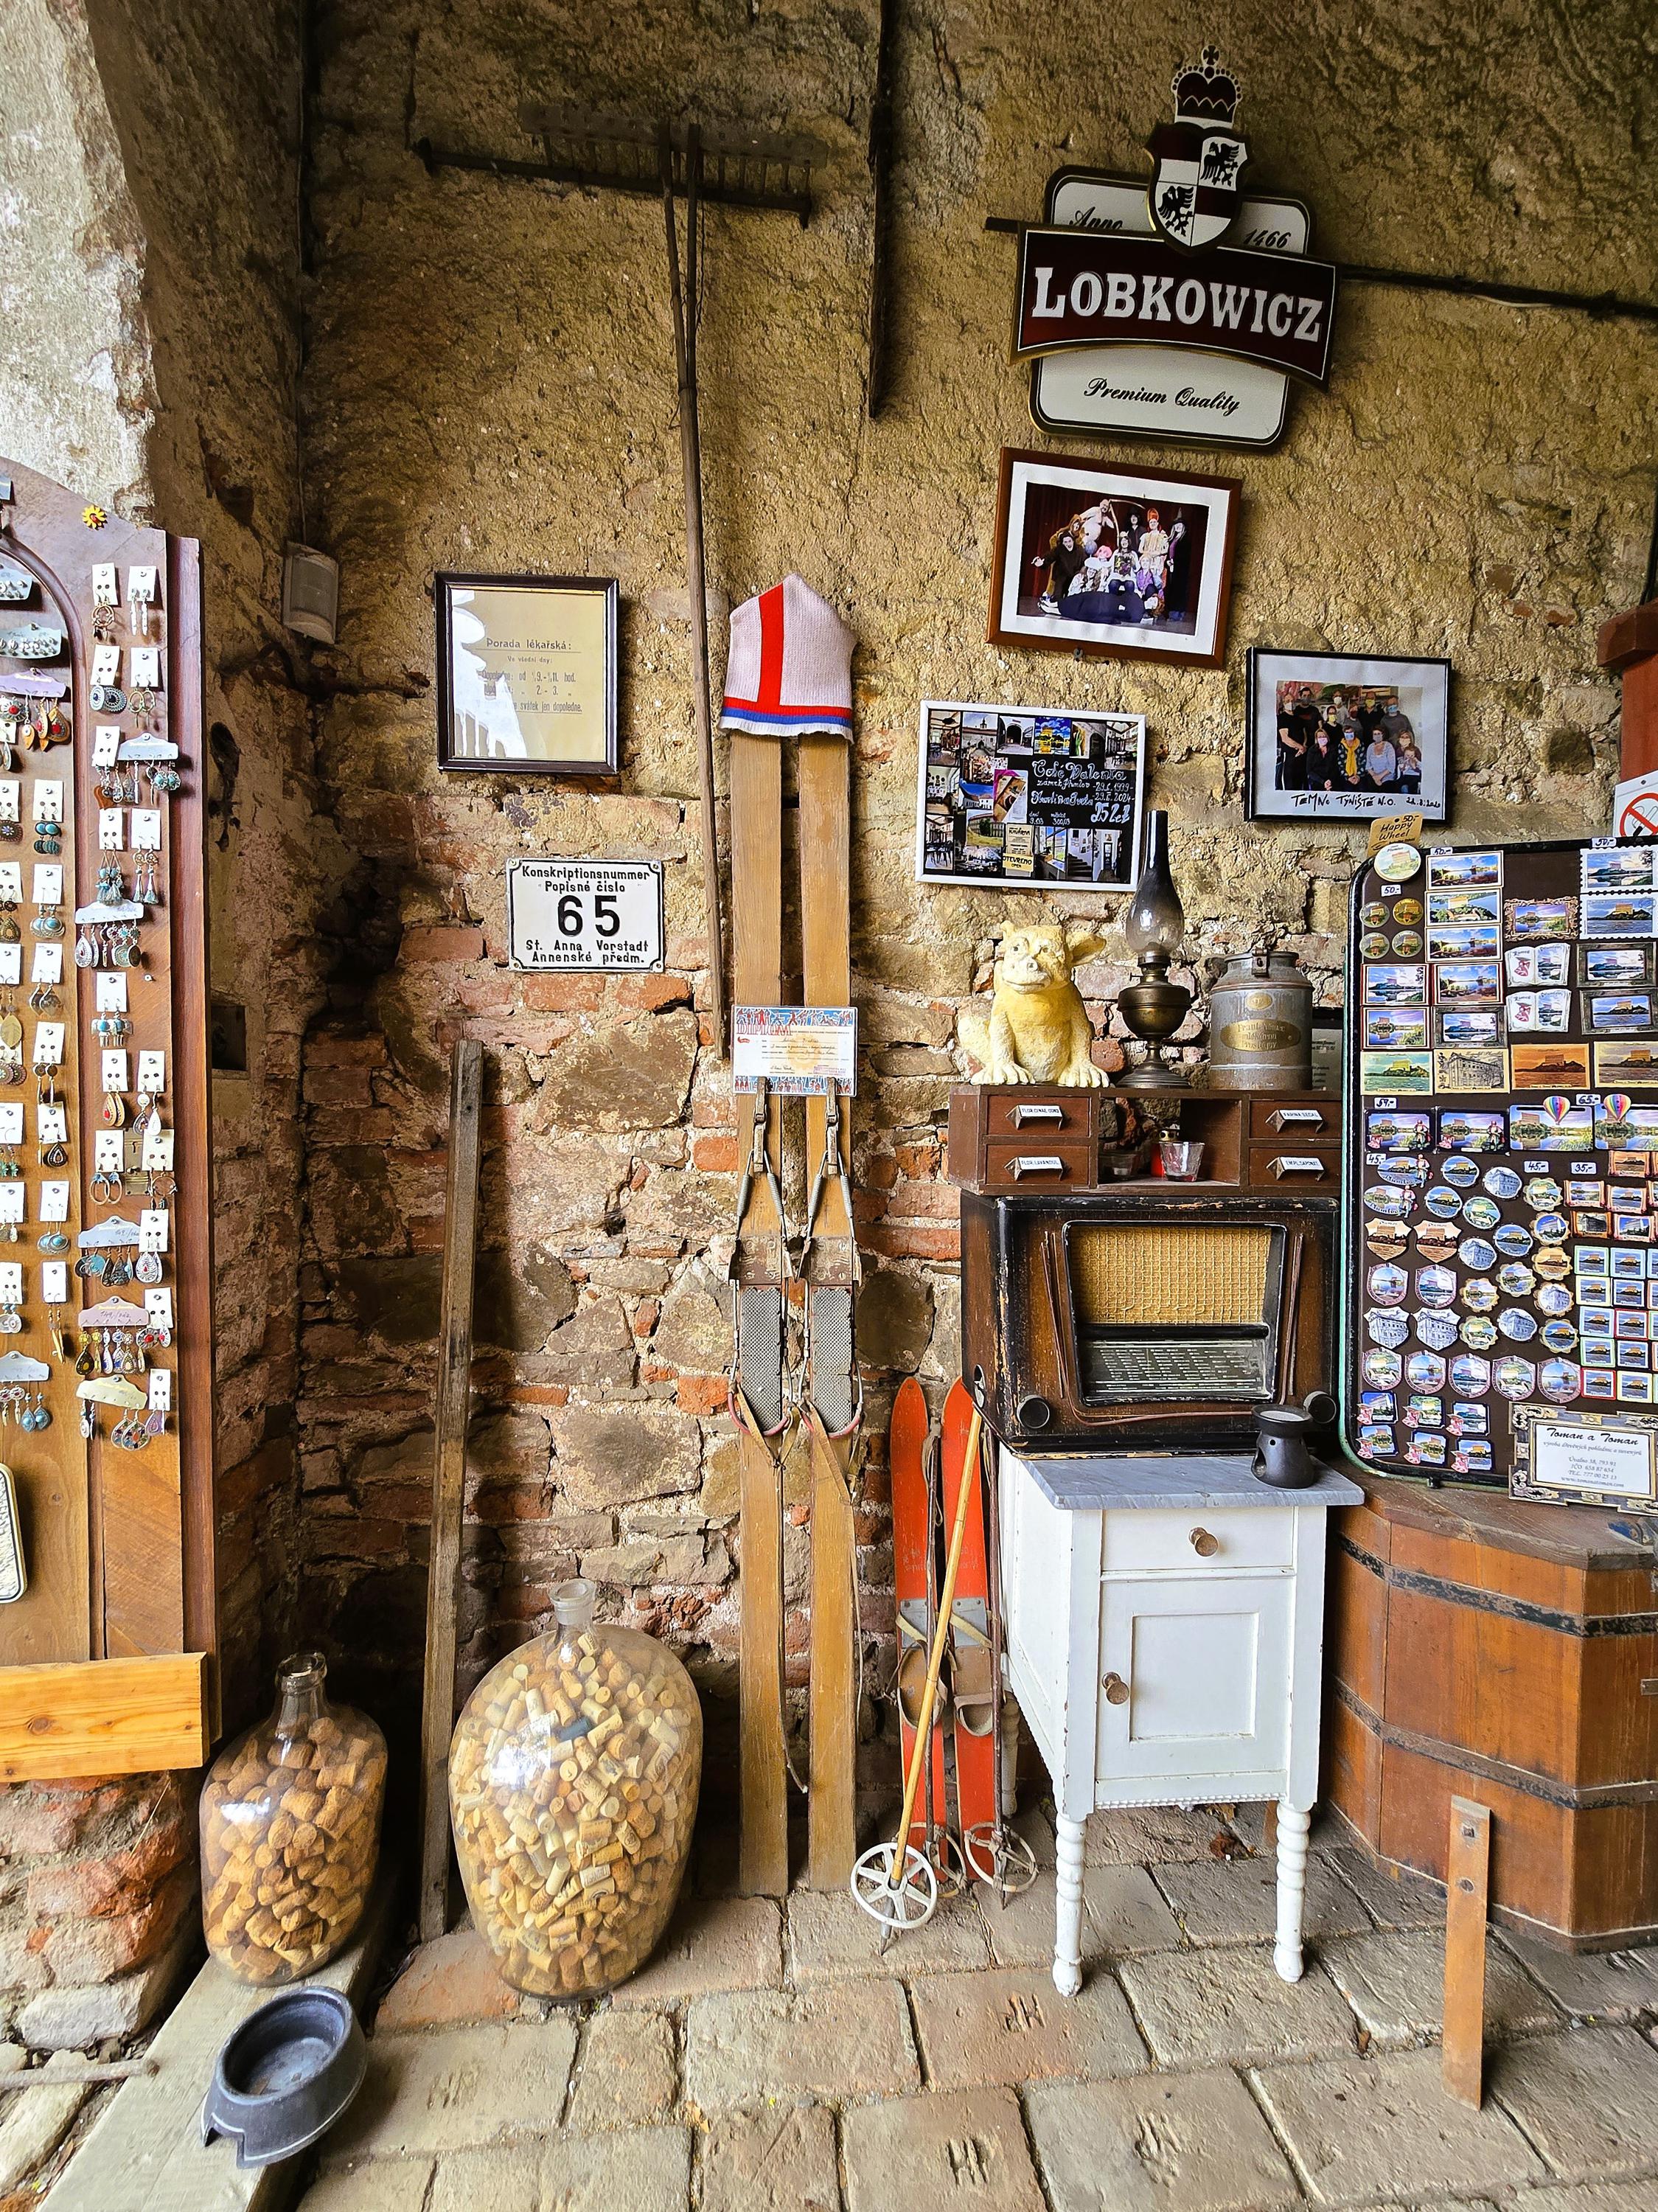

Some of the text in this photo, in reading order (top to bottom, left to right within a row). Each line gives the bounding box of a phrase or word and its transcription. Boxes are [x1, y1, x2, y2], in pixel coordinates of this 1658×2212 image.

[1244, 229, 1291, 248] 1466
[1031, 266, 1324, 343] LOBKOWICZ
[1084, 377, 1241, 416] Premium Quality
[487, 638, 571, 650] Porada lékařská:
[519, 671, 526, 681] od
[520, 700, 539, 711] svátek
[542, 702, 551, 712] jen
[553, 702, 582, 712] dopoledne.
[1065, 762, 1126, 781] Valenta
[1091, 801, 1110, 823] 25
[1381, 822, 1413, 832] Happy
[1379, 830, 1410, 841] Wheel
[522, 866, 650, 880] Konskriptionsnummer
[545, 880, 591, 894] Popisné
[557, 894, 621, 937] 65
[526, 939, 649, 952] St. Anna Vorstadt
[532, 951, 645, 964] Annenské předm.
[1547, 1427, 1584, 1440] Toman
[1600, 1433, 1639, 1445] Toman
